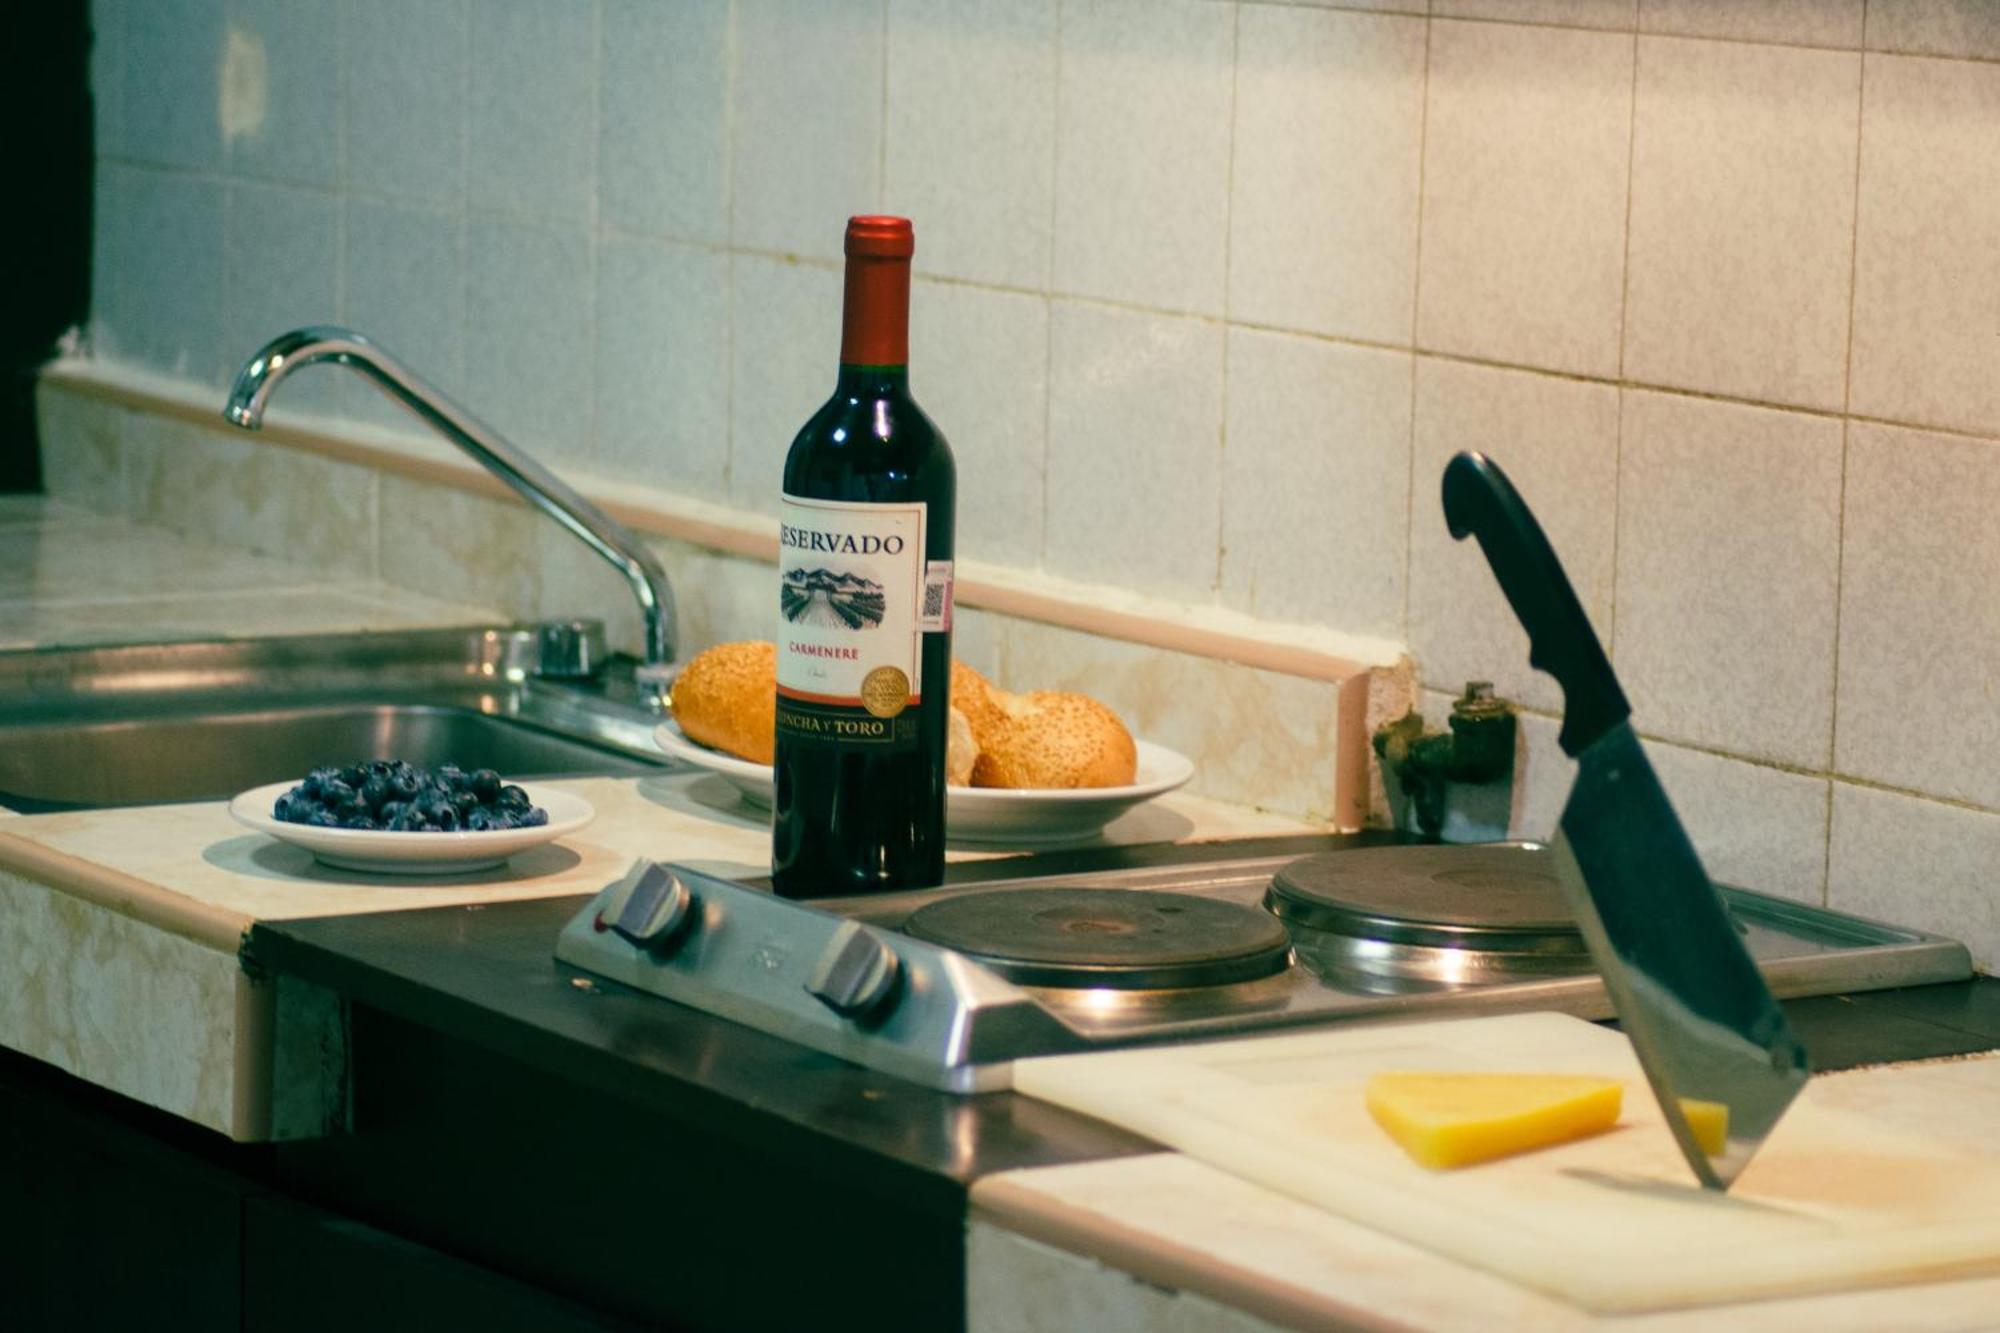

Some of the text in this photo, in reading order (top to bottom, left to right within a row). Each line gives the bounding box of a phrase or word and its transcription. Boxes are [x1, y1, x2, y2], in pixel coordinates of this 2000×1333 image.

[781, 523, 904, 555] ESERVADO
[789, 641, 859, 660] CARMENERE
[834, 720, 884, 737] TORO
